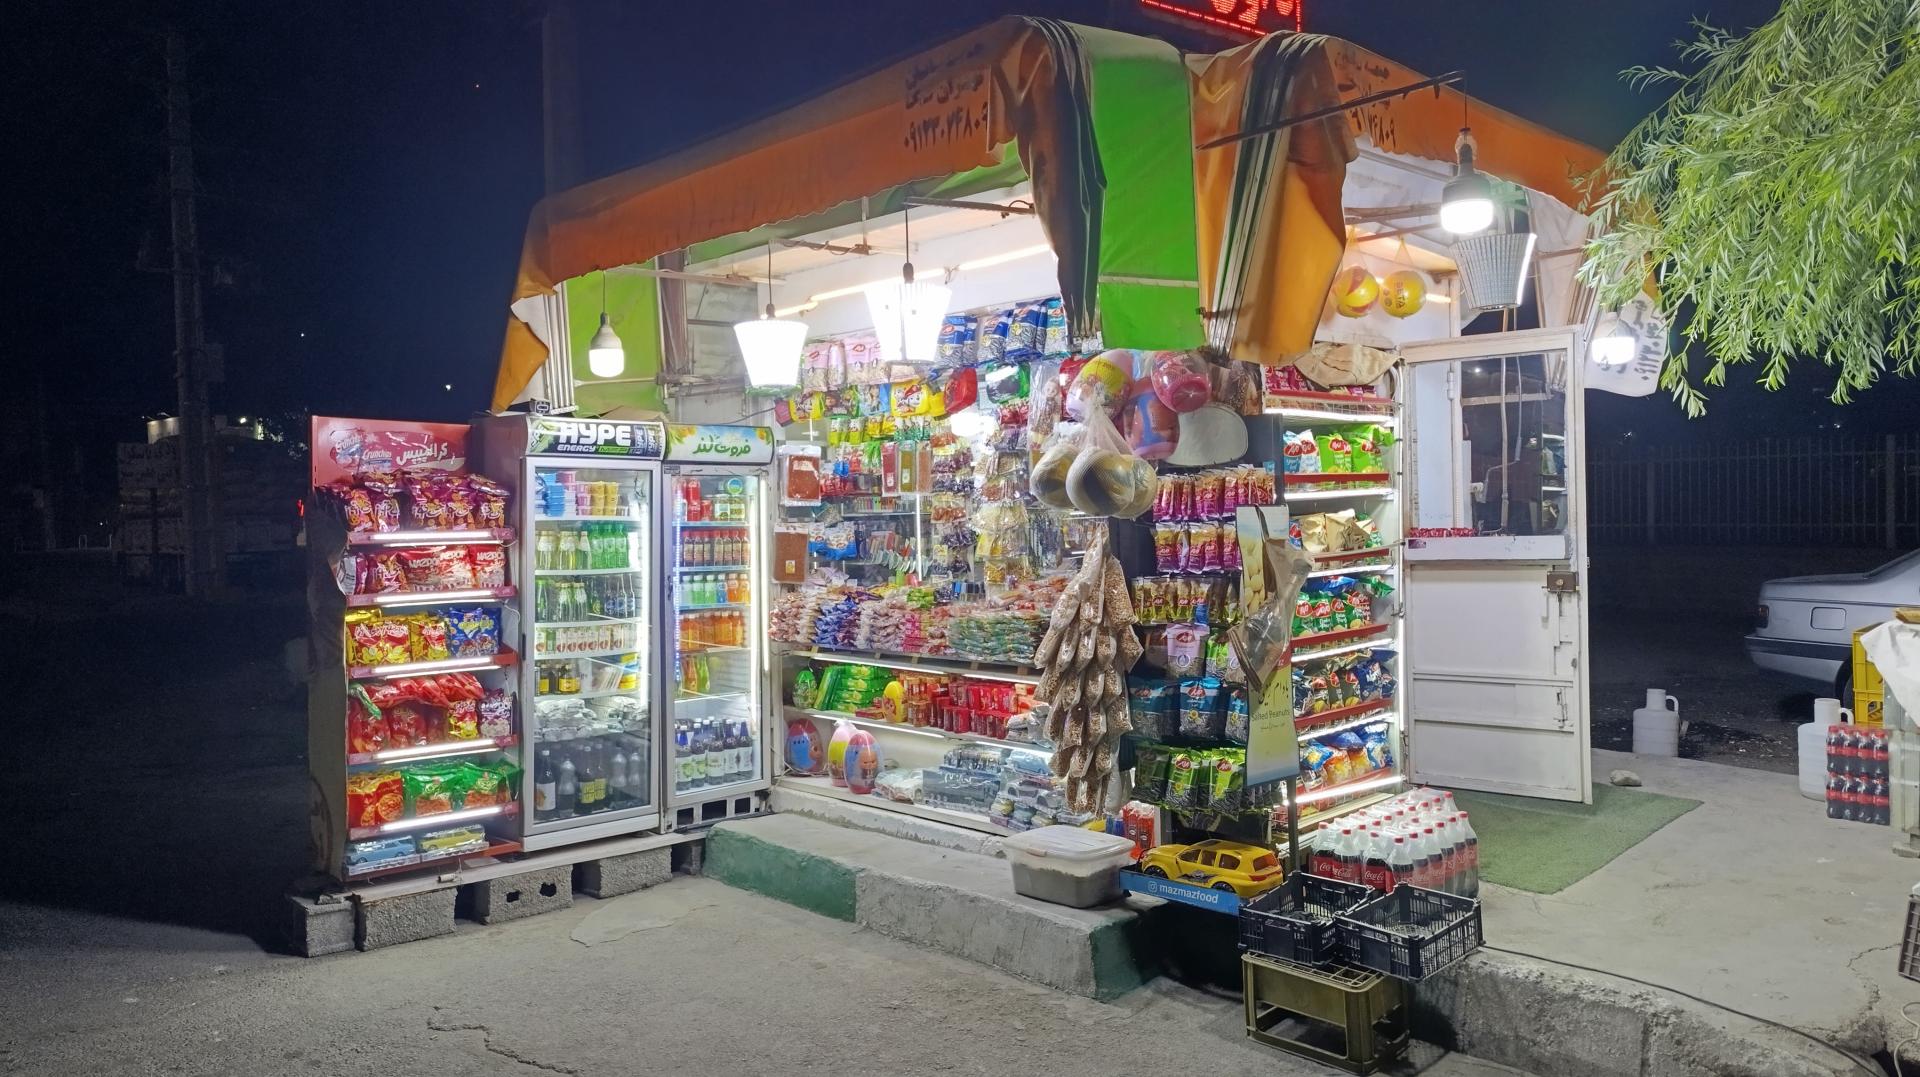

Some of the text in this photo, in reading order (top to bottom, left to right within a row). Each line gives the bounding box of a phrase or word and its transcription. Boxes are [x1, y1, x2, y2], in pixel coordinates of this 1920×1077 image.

[559, 422, 632, 446] HYPE
[557, 444, 596, 453] ENERGY
[1251, 709, 1291, 721] Salted Peanuts
[1159, 883, 1218, 904] mazmazfood
